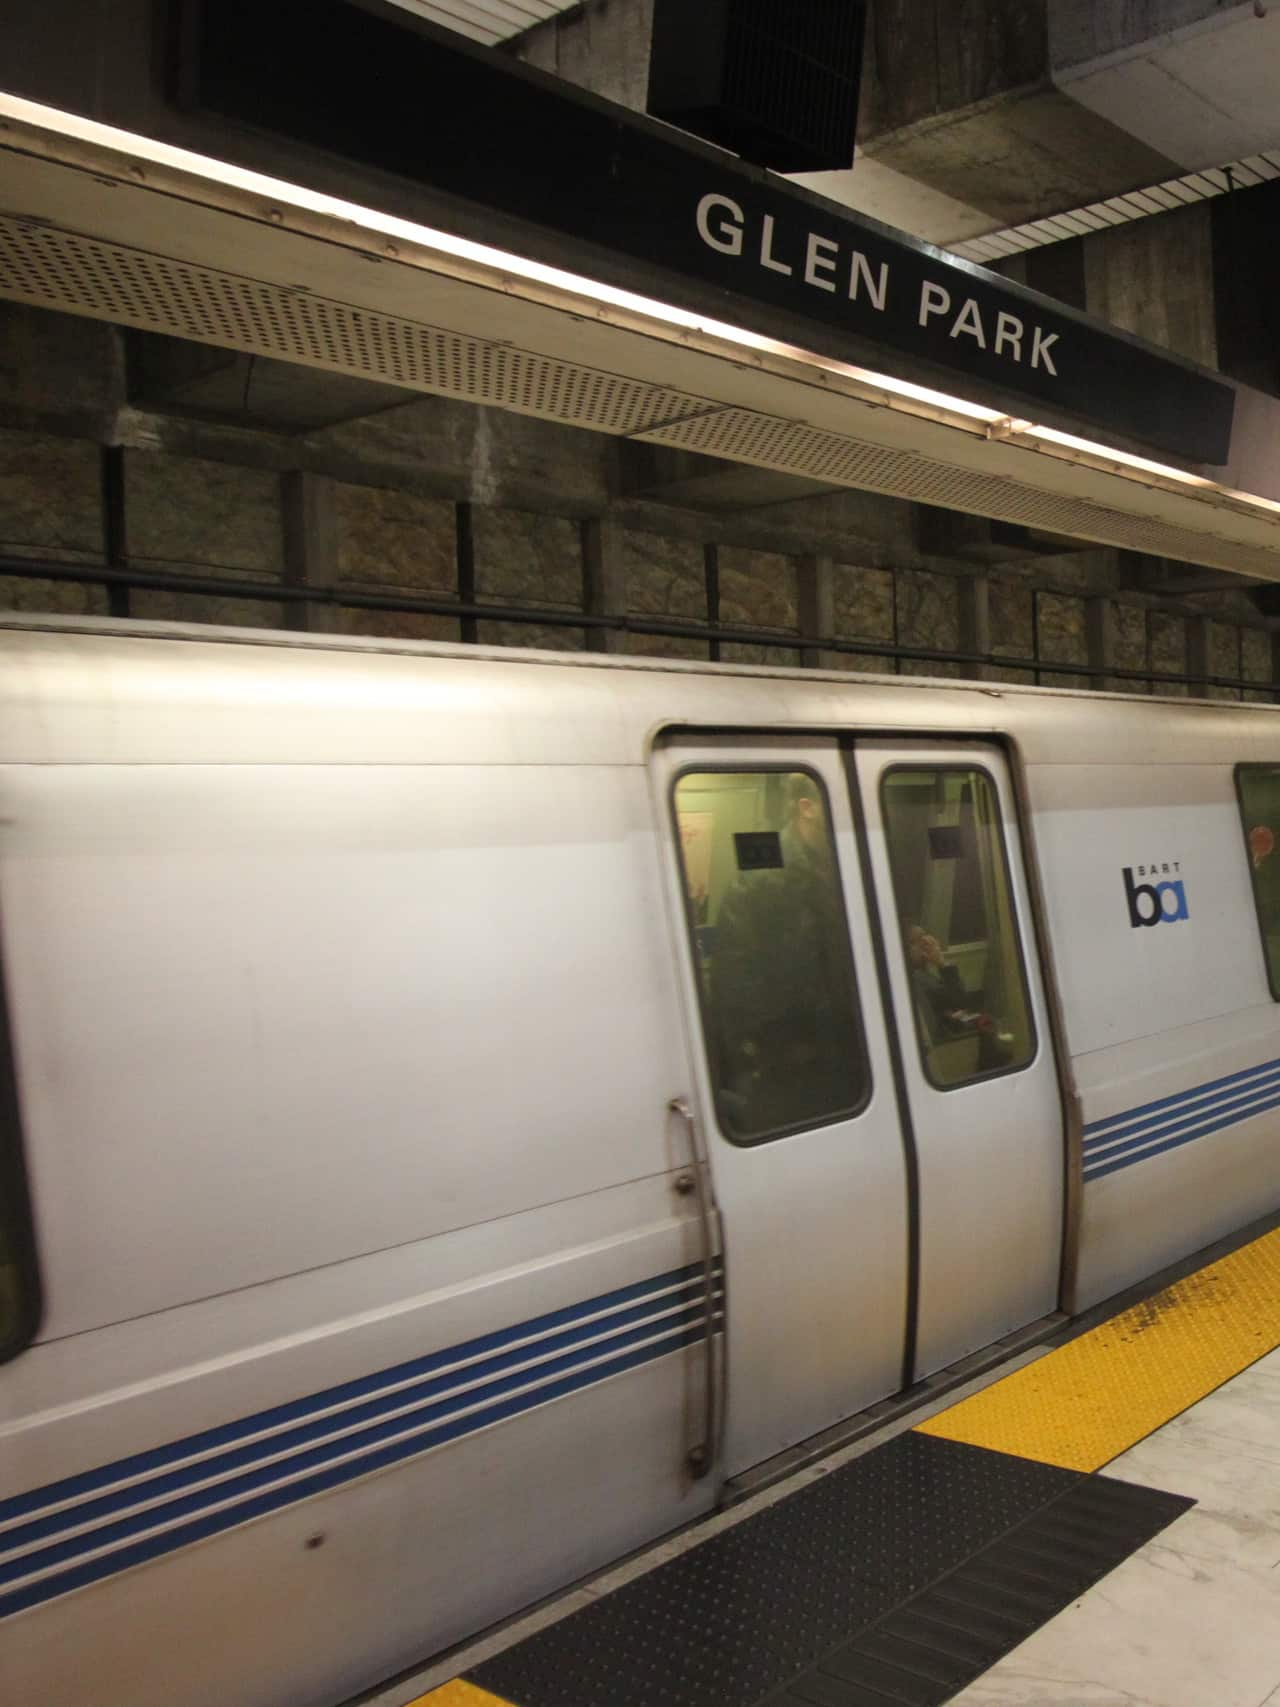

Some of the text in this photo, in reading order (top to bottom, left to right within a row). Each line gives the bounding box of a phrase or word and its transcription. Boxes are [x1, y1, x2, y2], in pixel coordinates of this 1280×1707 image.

[696, 193, 1060, 377] GLEN PARK
[1138, 862, 1180, 876] BART
